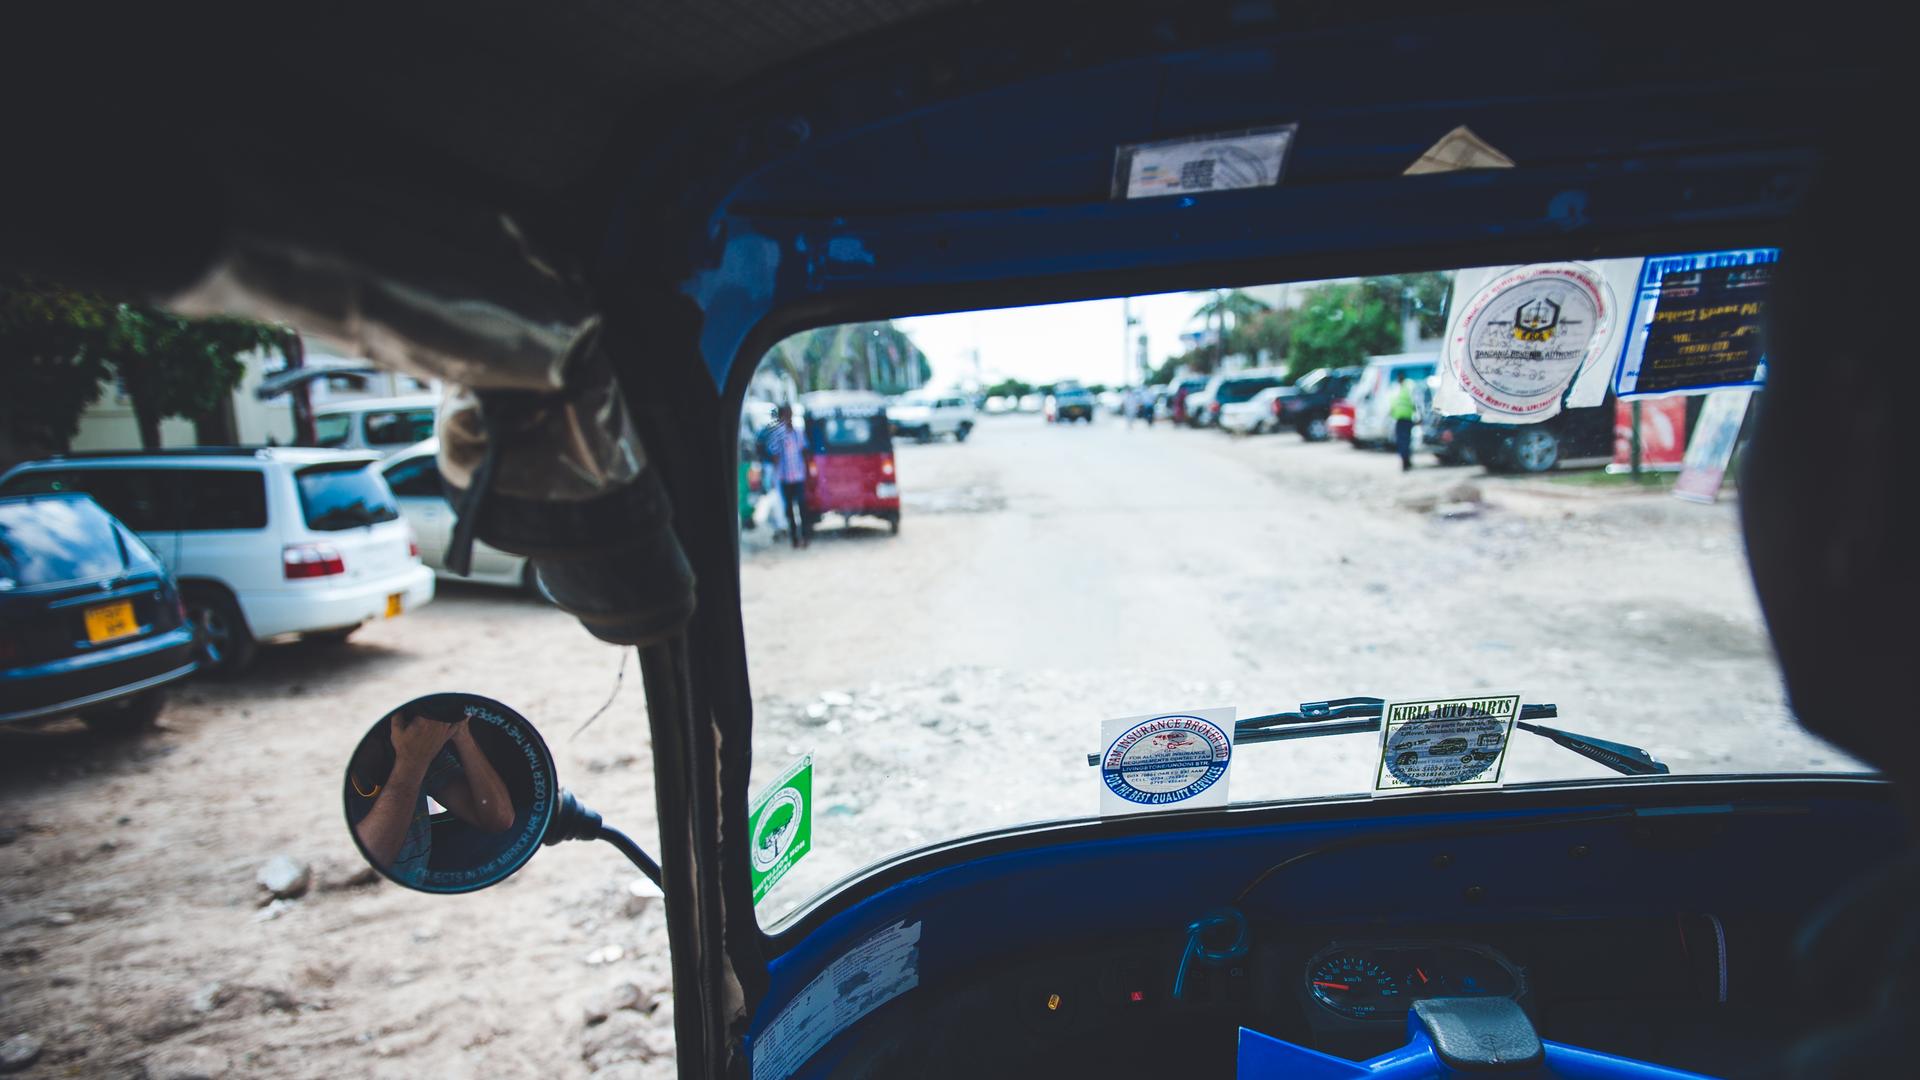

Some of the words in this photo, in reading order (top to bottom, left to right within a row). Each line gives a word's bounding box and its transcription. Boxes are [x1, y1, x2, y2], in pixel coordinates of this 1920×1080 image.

[1475, 350, 1509, 360] TANZANIA
[1545, 350, 1581, 360] AUTHORITY
[464, 704, 504, 725] APPEAR
[1393, 705, 1430, 721] KIRIA
[1432, 702, 1467, 718] AUTO
[1468, 700, 1511, 716] PARTS
[503, 721, 526, 746] THEY
[1117, 719, 1182, 750] INSURANCE
[1184, 719, 1222, 743] BROKER
[1214, 741, 1228, 759] LTD
[524, 743, 542, 770] THAN
[532, 770, 547, 811] CLOSER
[1104, 771, 1118, 787] FOR
[1115, 781, 1130, 797] THE
[1131, 788, 1151, 803] BEST
[1152, 787, 1191, 804] QUALITY
[525, 814, 542, 839] ARE
[498, 831, 533, 866] MIRROR
[478, 863, 497, 877] THE
